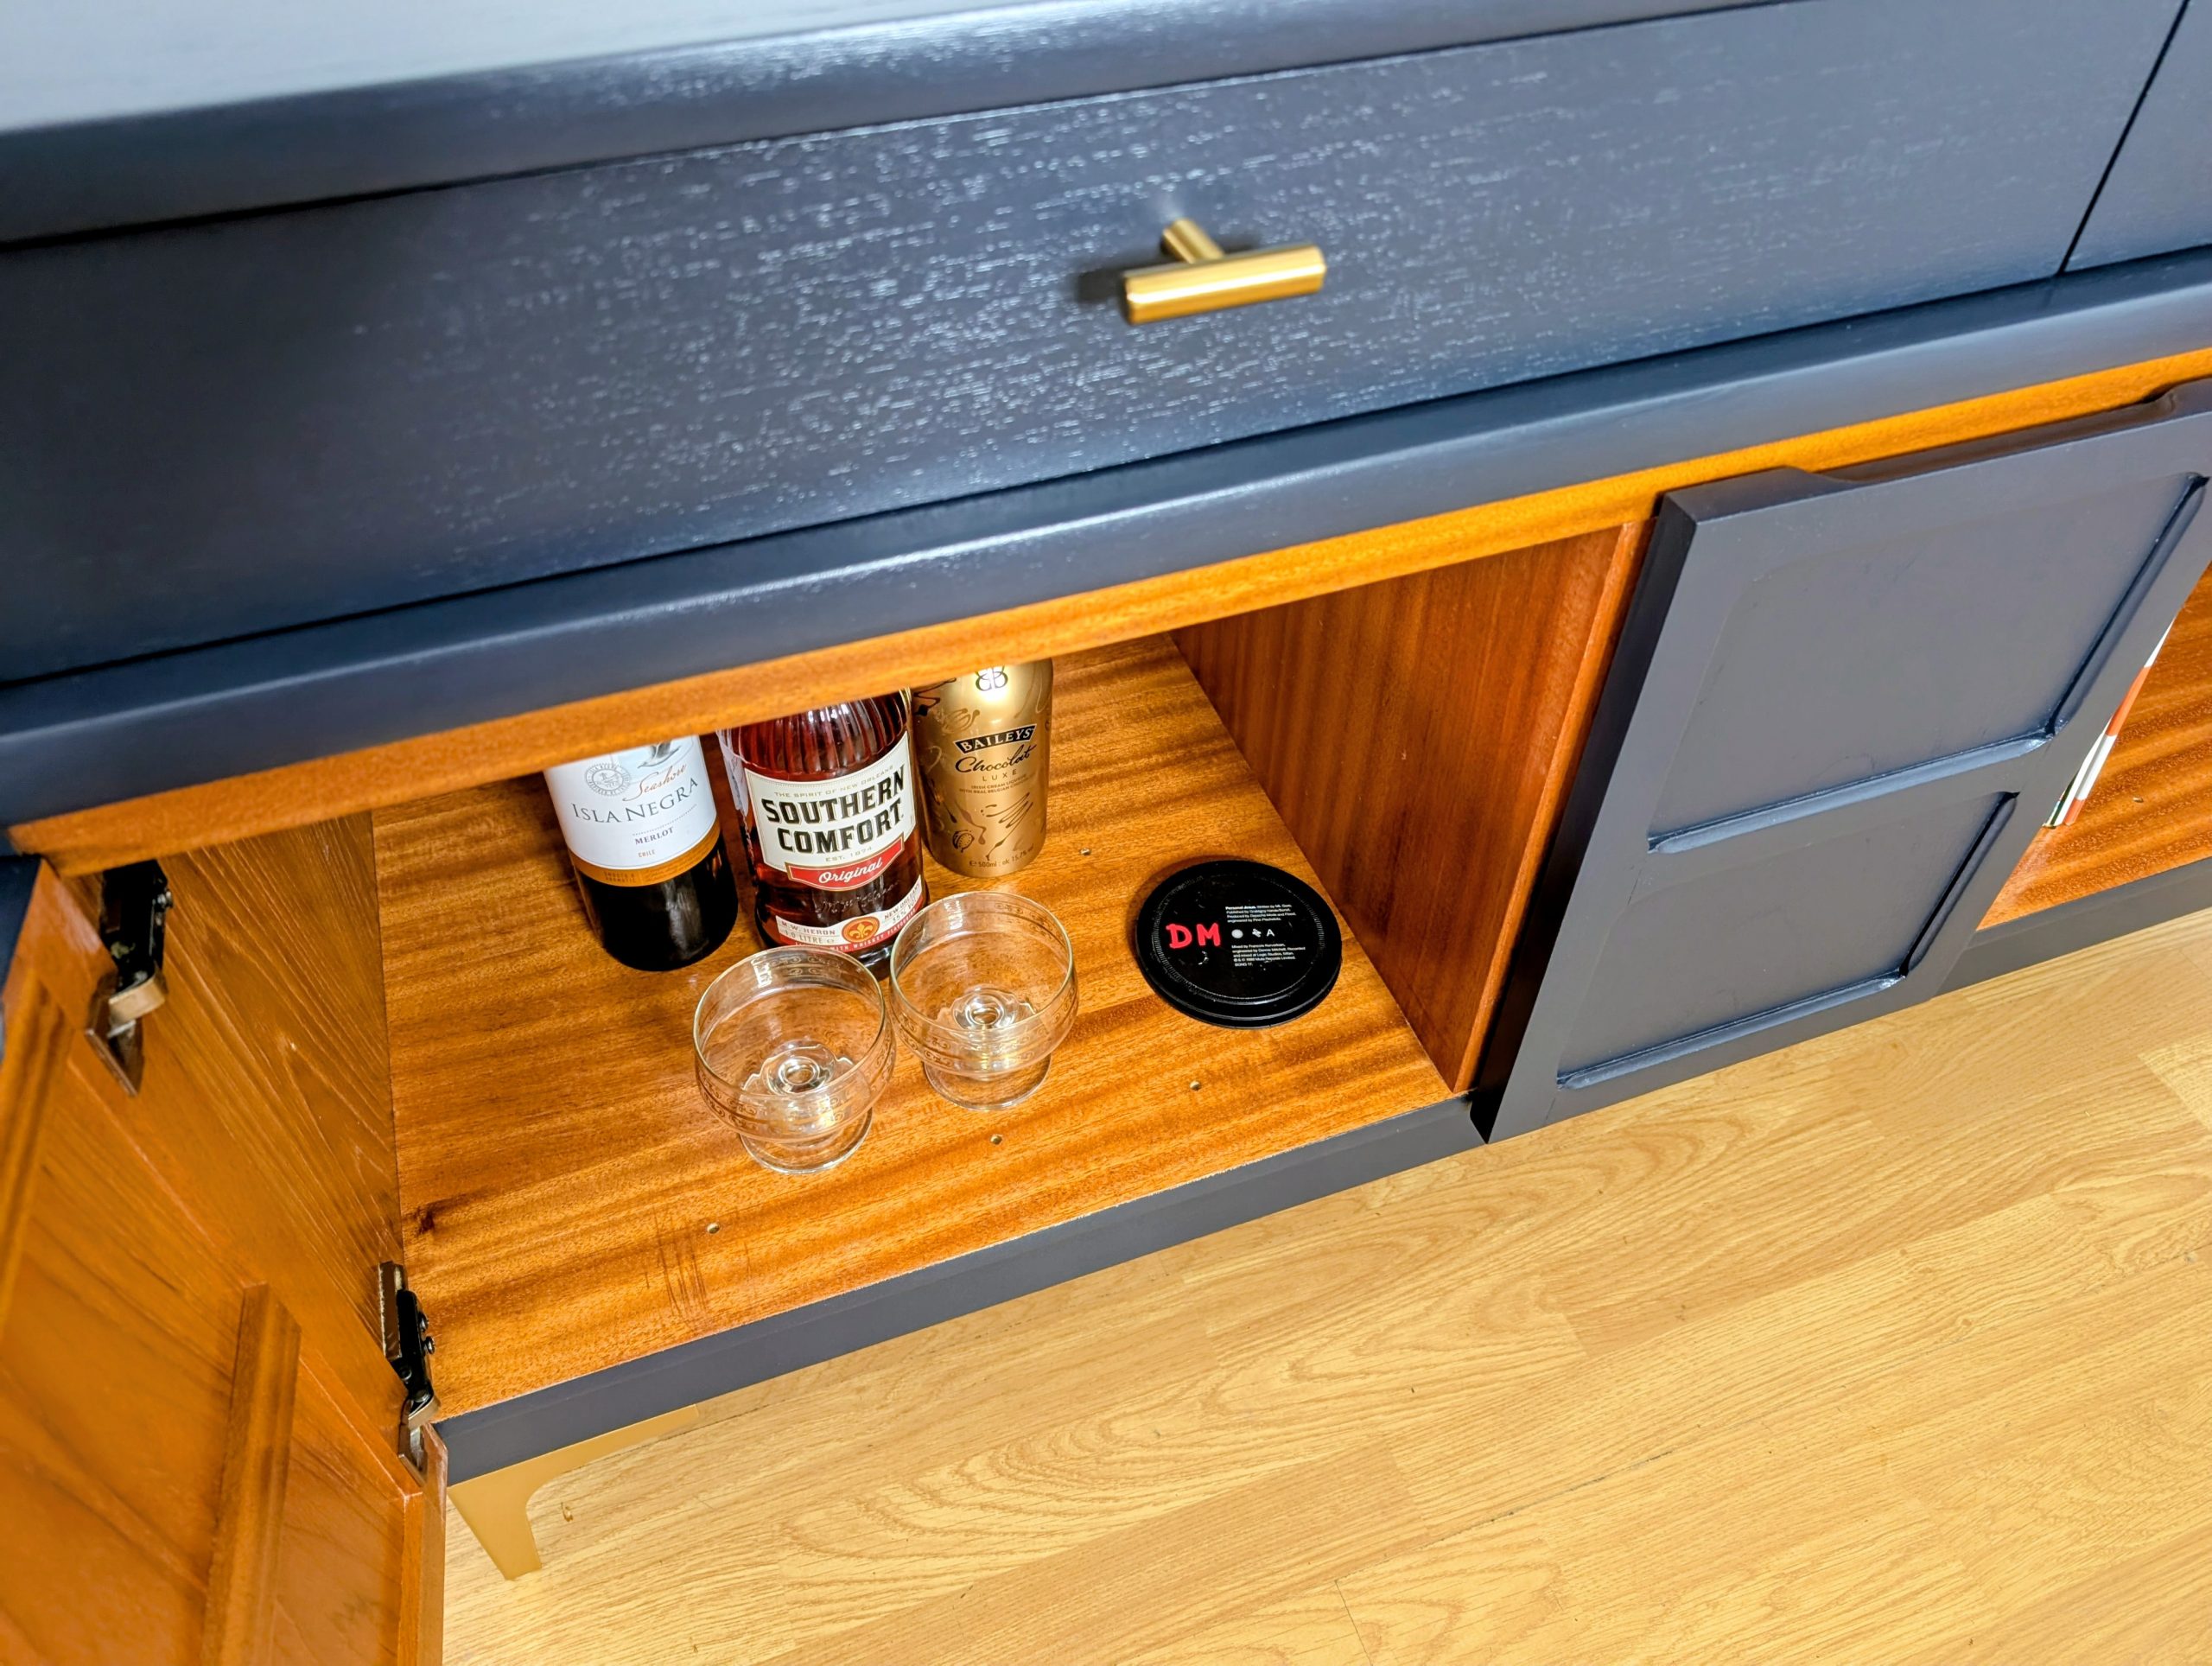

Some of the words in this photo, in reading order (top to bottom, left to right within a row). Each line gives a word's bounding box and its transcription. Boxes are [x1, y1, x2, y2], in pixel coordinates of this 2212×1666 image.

[960, 728, 1033, 751] BAILEYS
[955, 744, 1037, 773] Chocolat
[622, 763, 687, 801] Seashore
[861, 765, 893, 785] ORLEANS
[982, 769, 1017, 781] LUXE
[571, 803, 622, 823] ISLA
[625, 777, 699, 822] NEGRA
[761, 764, 906, 824] SOUTHERN
[634, 827, 674, 845] MERLOT
[638, 849, 656, 858] CHILE
[818, 857, 883, 884] Original
[800, 935, 823, 944] LITRE
[852, 933, 885, 949] WHISKEY
[1166, 922, 1221, 949] DM
